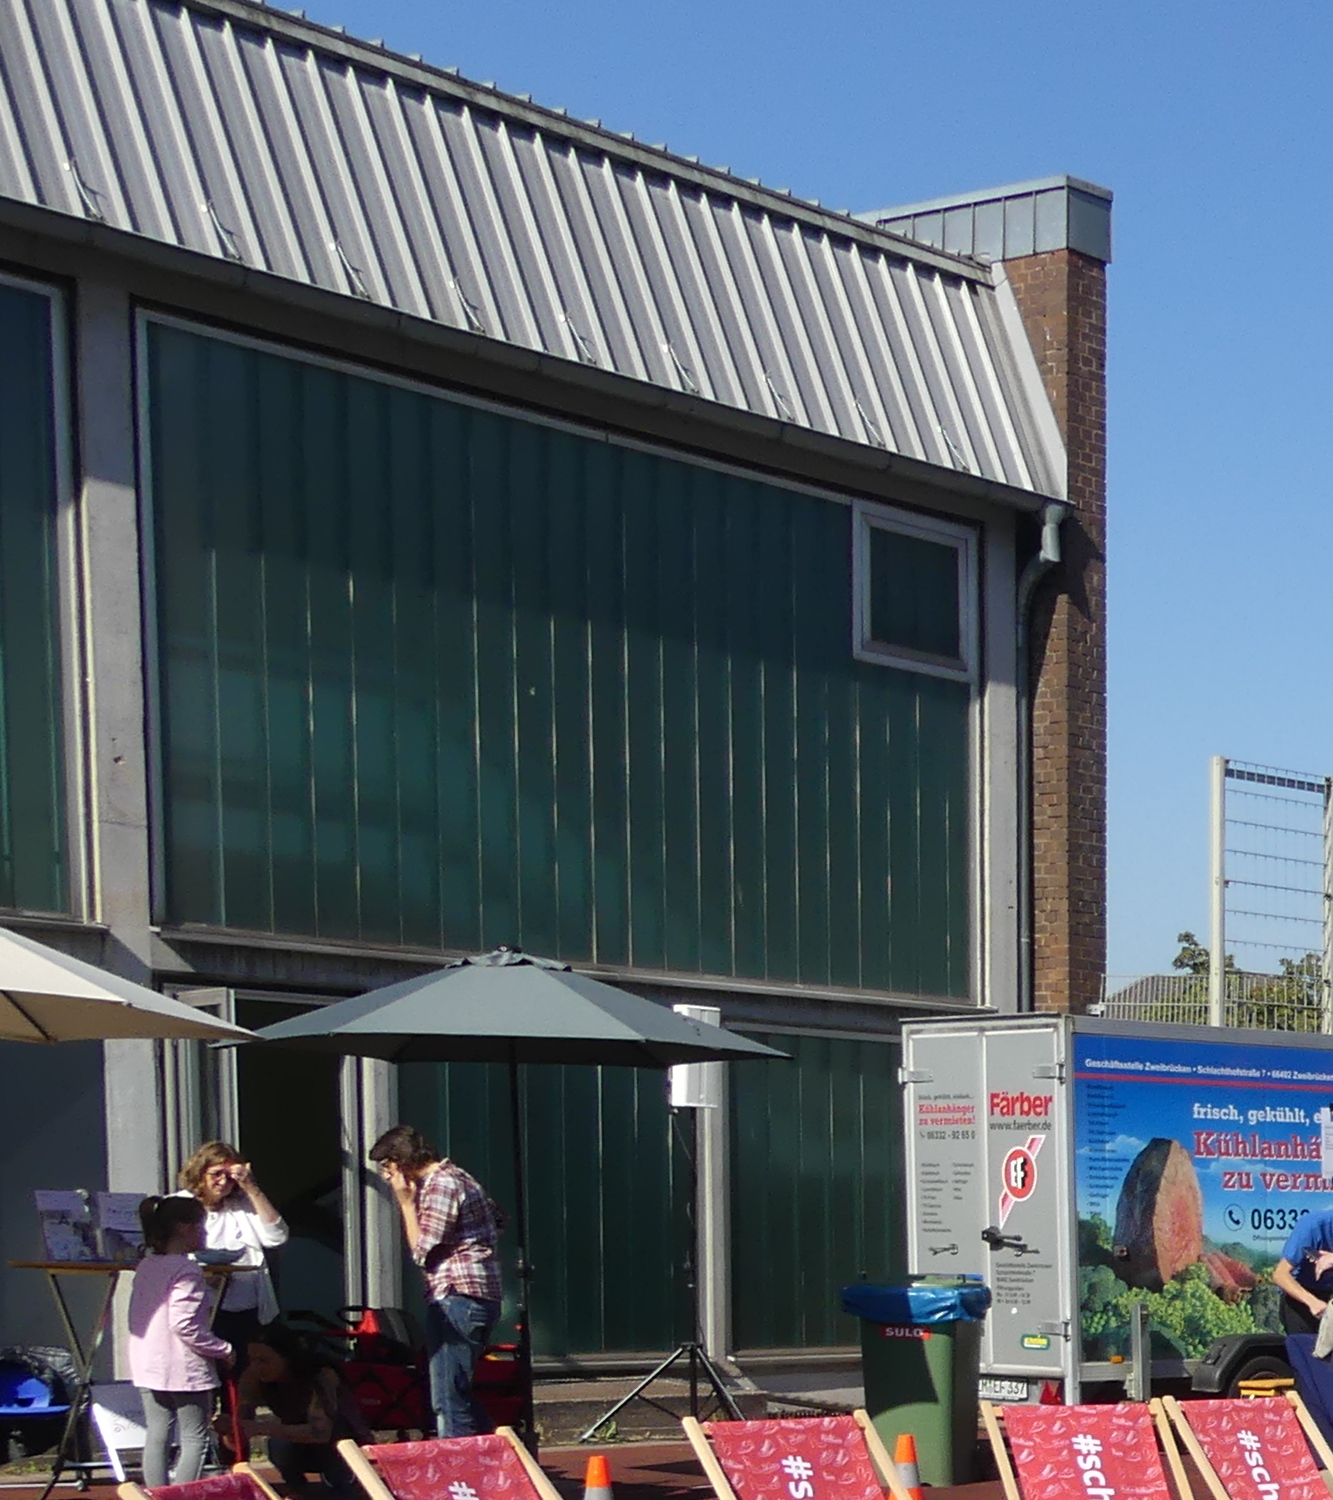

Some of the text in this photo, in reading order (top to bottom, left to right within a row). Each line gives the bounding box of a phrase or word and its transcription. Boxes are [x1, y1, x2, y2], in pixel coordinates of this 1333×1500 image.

[918, 1103, 975, 1116] Kühlanhänger
[990, 1092, 1053, 1116] Färber
[930, 1116, 976, 1126] vermieten!
[1193, 1103, 1244, 1124] frisch,
[1247, 1106, 1310, 1127] gekühlt,
[989, 1120, 1053, 1132] www.faerber.de
[1223, 1172, 1254, 1192] zu
[885, 1327, 924, 1337] SULO
